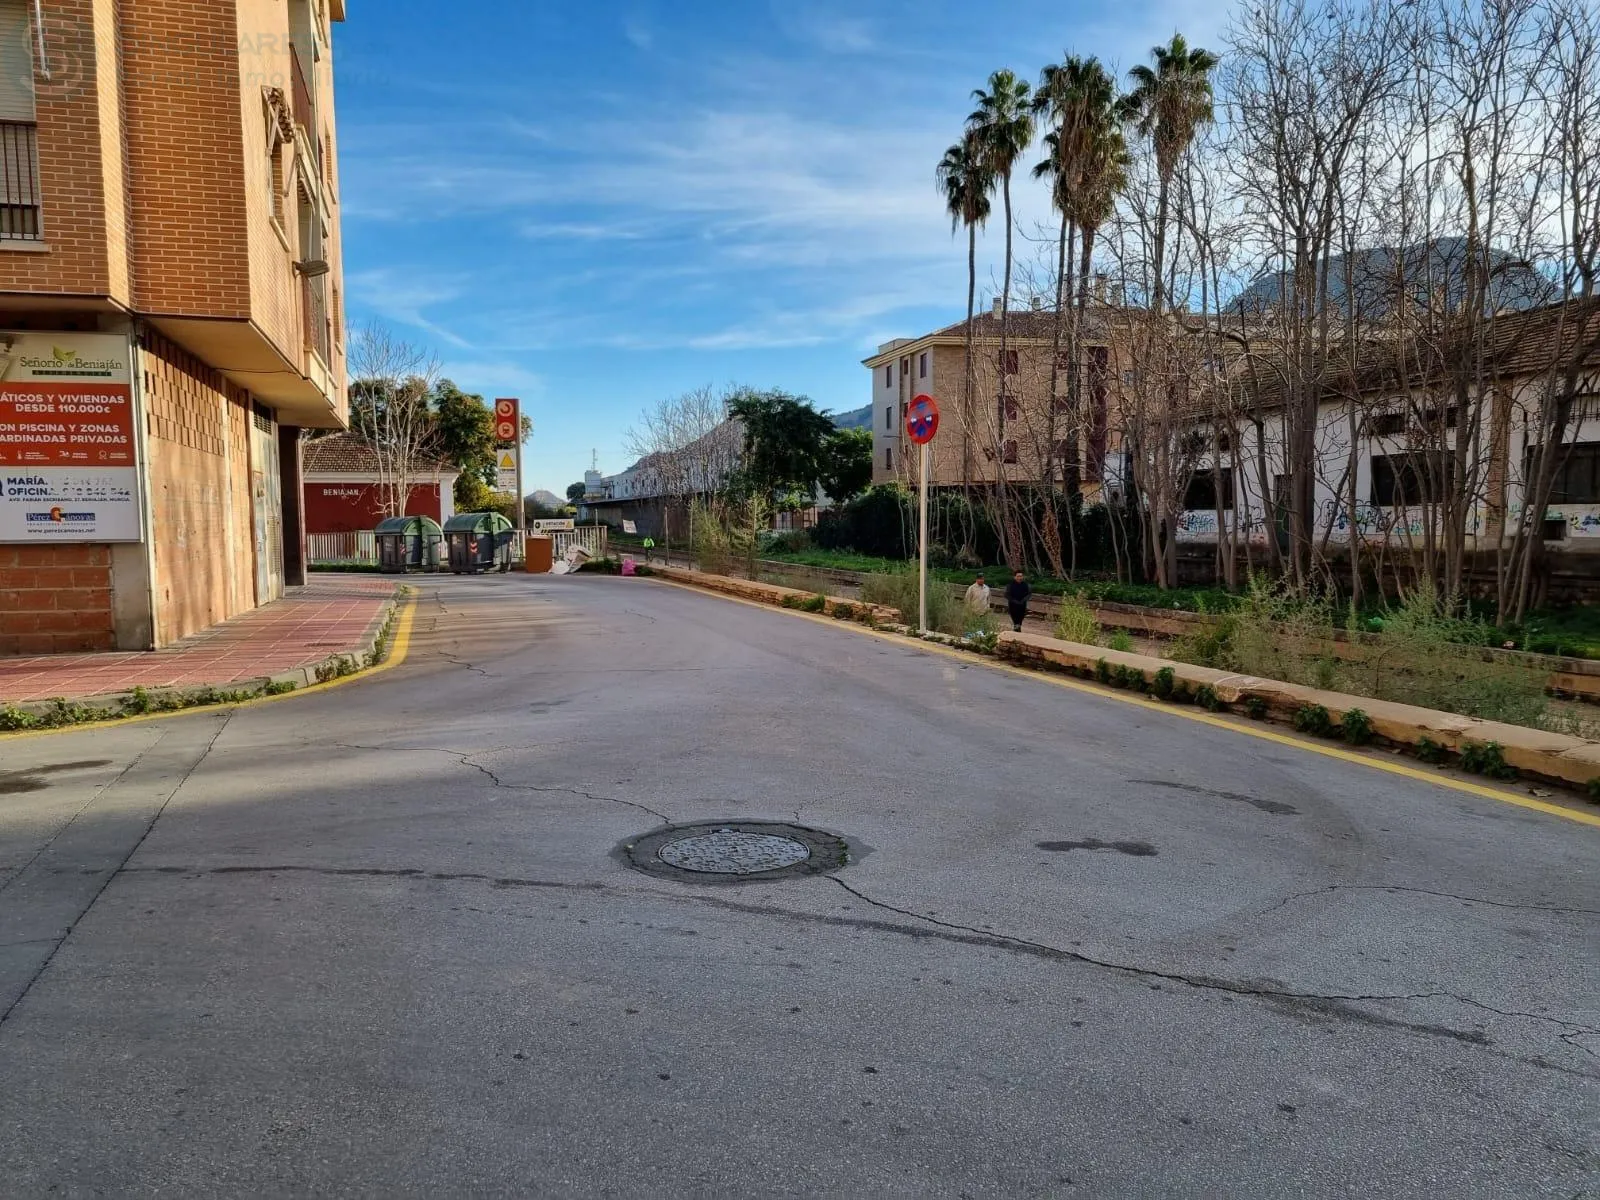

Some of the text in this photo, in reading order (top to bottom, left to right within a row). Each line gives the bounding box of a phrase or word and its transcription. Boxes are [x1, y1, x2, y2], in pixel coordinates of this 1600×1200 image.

[75, 358, 122, 371] Beniaján
[0, 392, 125, 404] ÁTICOS Y VIVIENDAS
[15, 404, 111, 413] DESDE 110.000€
[19, 424, 65, 432] PISCINA
[69, 424, 76, 432] Y
[80, 425, 120, 433] ZONAS
[0, 434, 128, 444] ARDINADAS PRIVADAS
[27, 513, 51, 521] Pérez
